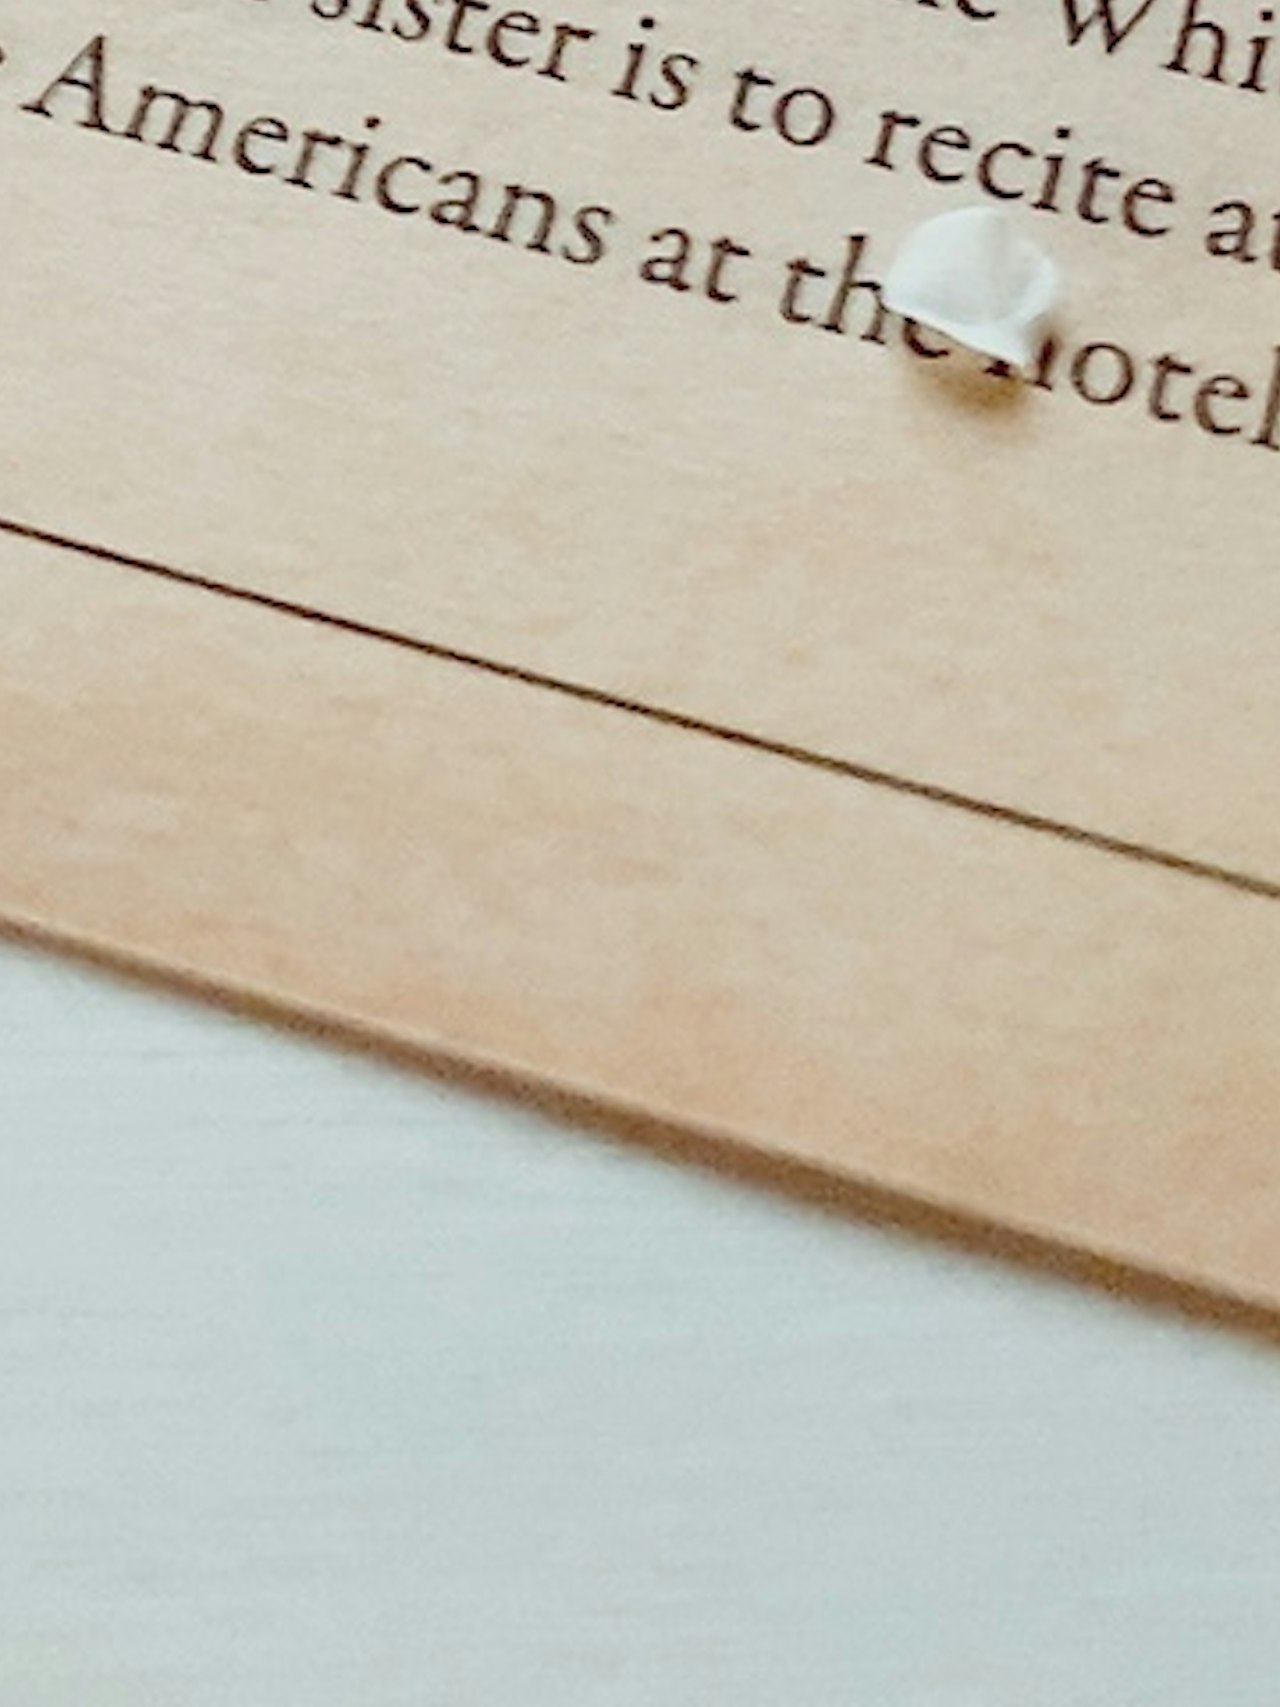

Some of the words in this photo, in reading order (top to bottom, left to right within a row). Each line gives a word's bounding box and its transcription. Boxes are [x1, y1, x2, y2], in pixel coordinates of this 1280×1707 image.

[19, 34, 615, 266] Americans
[610, 15, 701, 111] is
[728, 66, 838, 148] to
[864, 110, 1177, 239] recite
